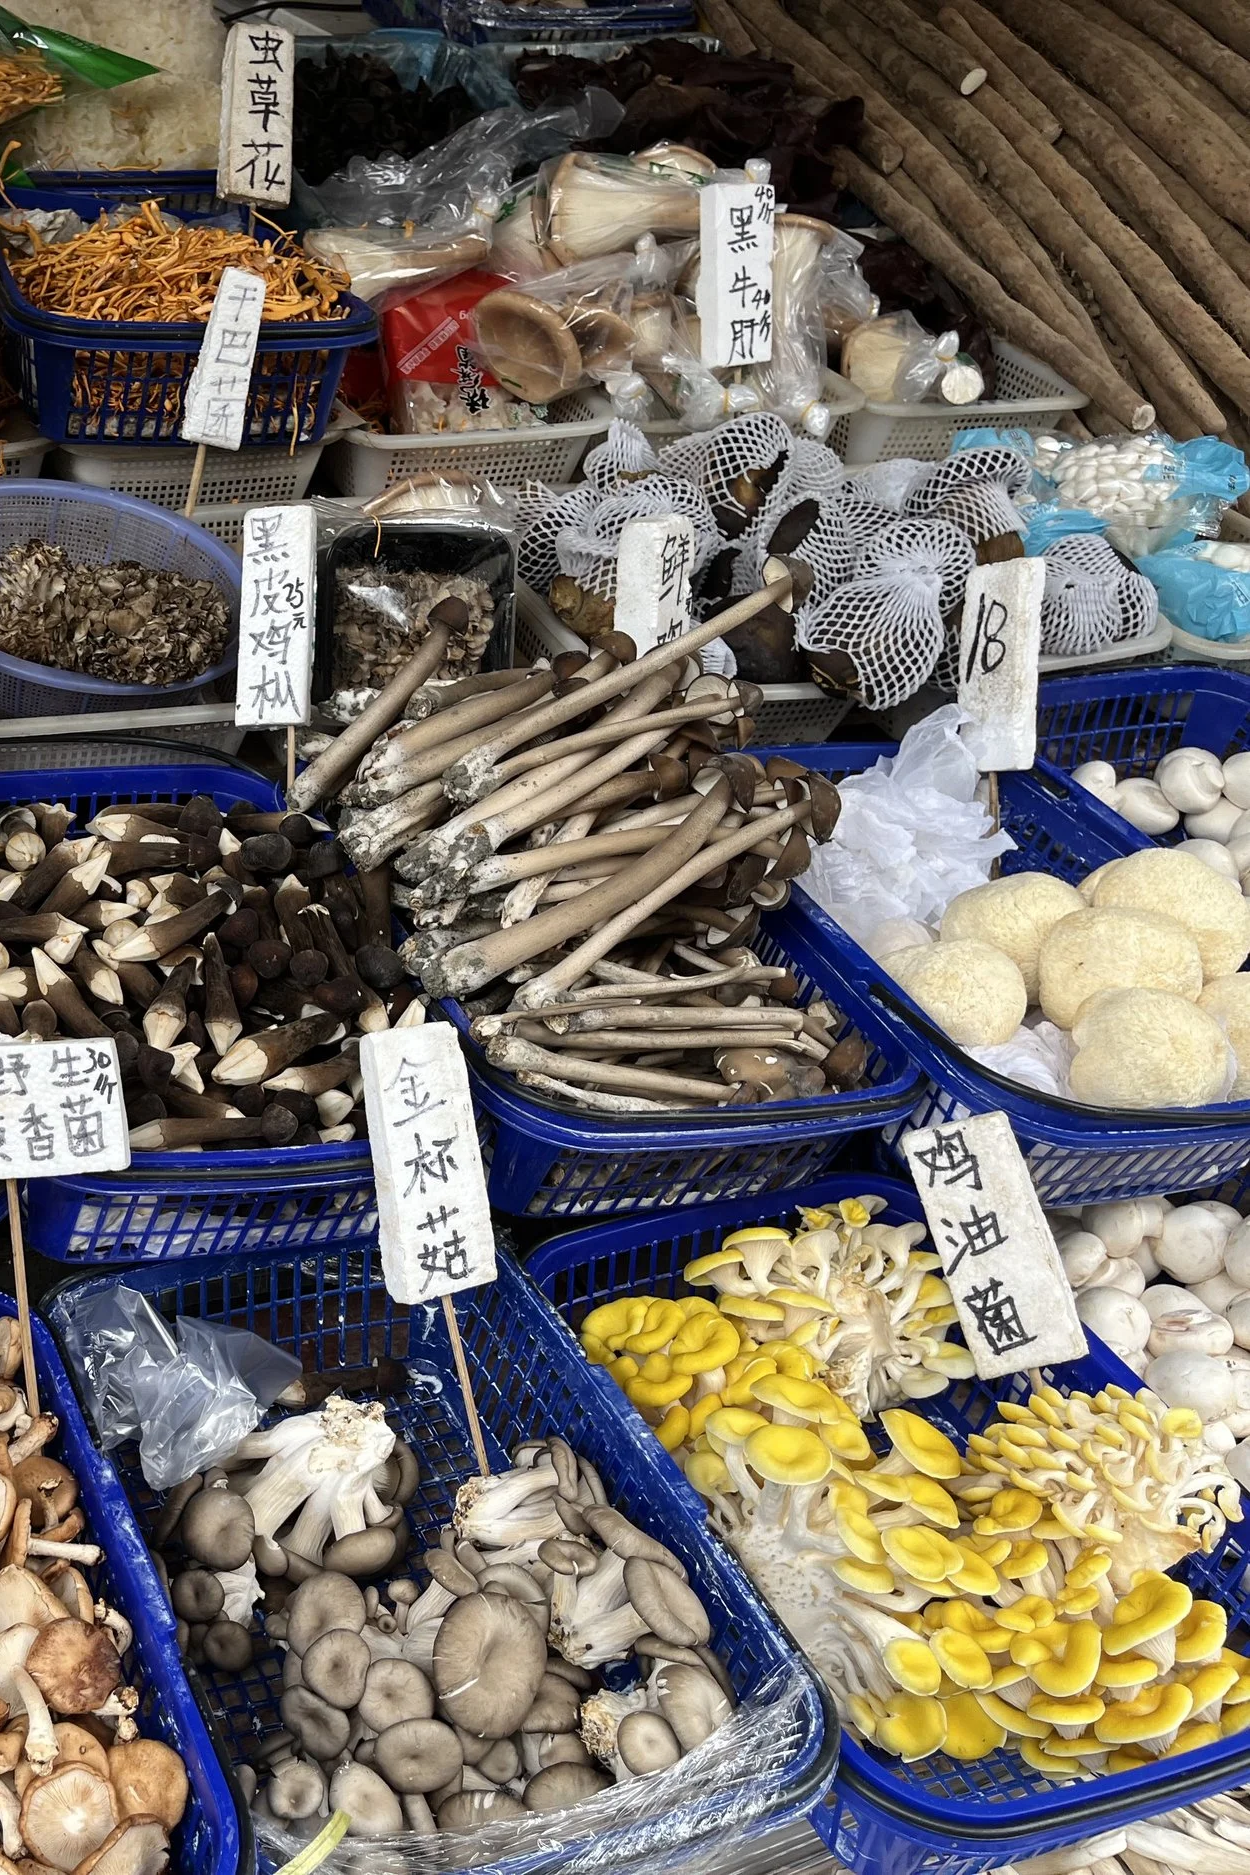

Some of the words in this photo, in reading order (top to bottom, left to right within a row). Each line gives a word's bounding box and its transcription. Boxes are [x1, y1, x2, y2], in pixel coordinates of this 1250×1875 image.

[236, 31, 285, 191] 虫草花
[727, 205, 759, 365] 黑牛肝
[247, 513, 301, 719] 黑皮鸡枞
[966, 593, 1007, 683] 18
[384, 1057, 476, 1294] 金杯菇
[914, 1128, 1038, 1355] 鸡油菌
